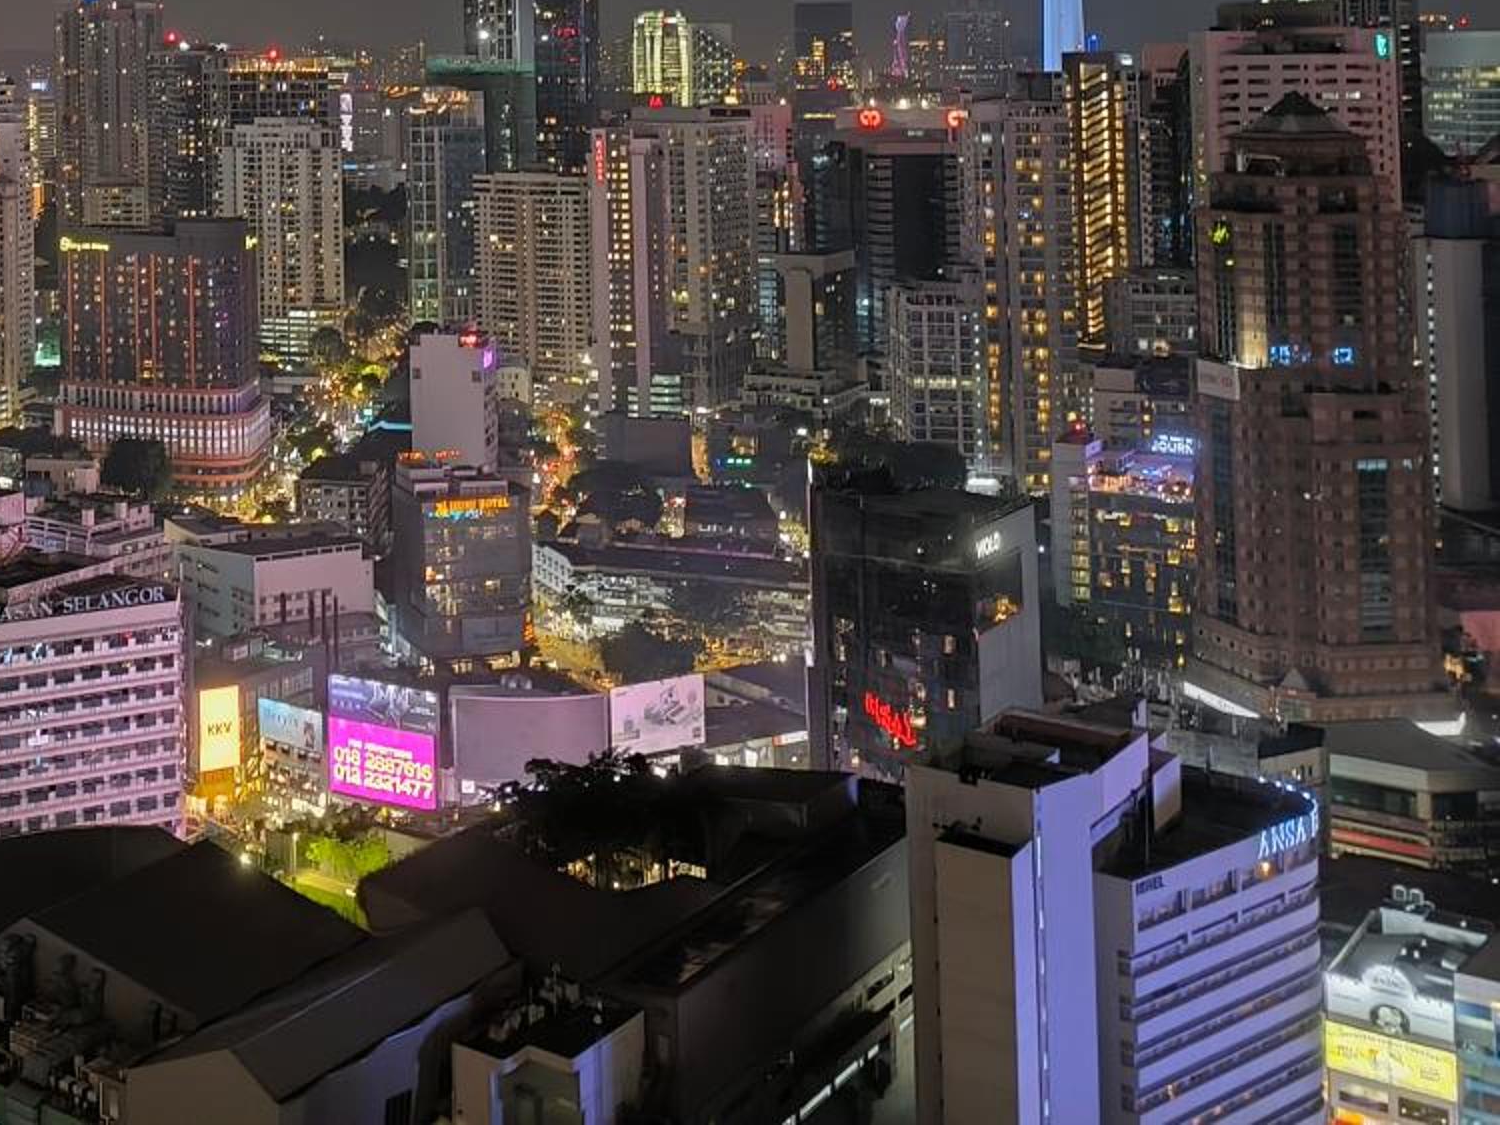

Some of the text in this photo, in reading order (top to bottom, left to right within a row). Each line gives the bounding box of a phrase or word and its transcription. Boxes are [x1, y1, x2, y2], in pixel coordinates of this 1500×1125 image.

[63, 586, 165, 614] SELANGOR
[207, 721, 233, 736] KKV
[1258, 816, 1307, 860] ANSA
